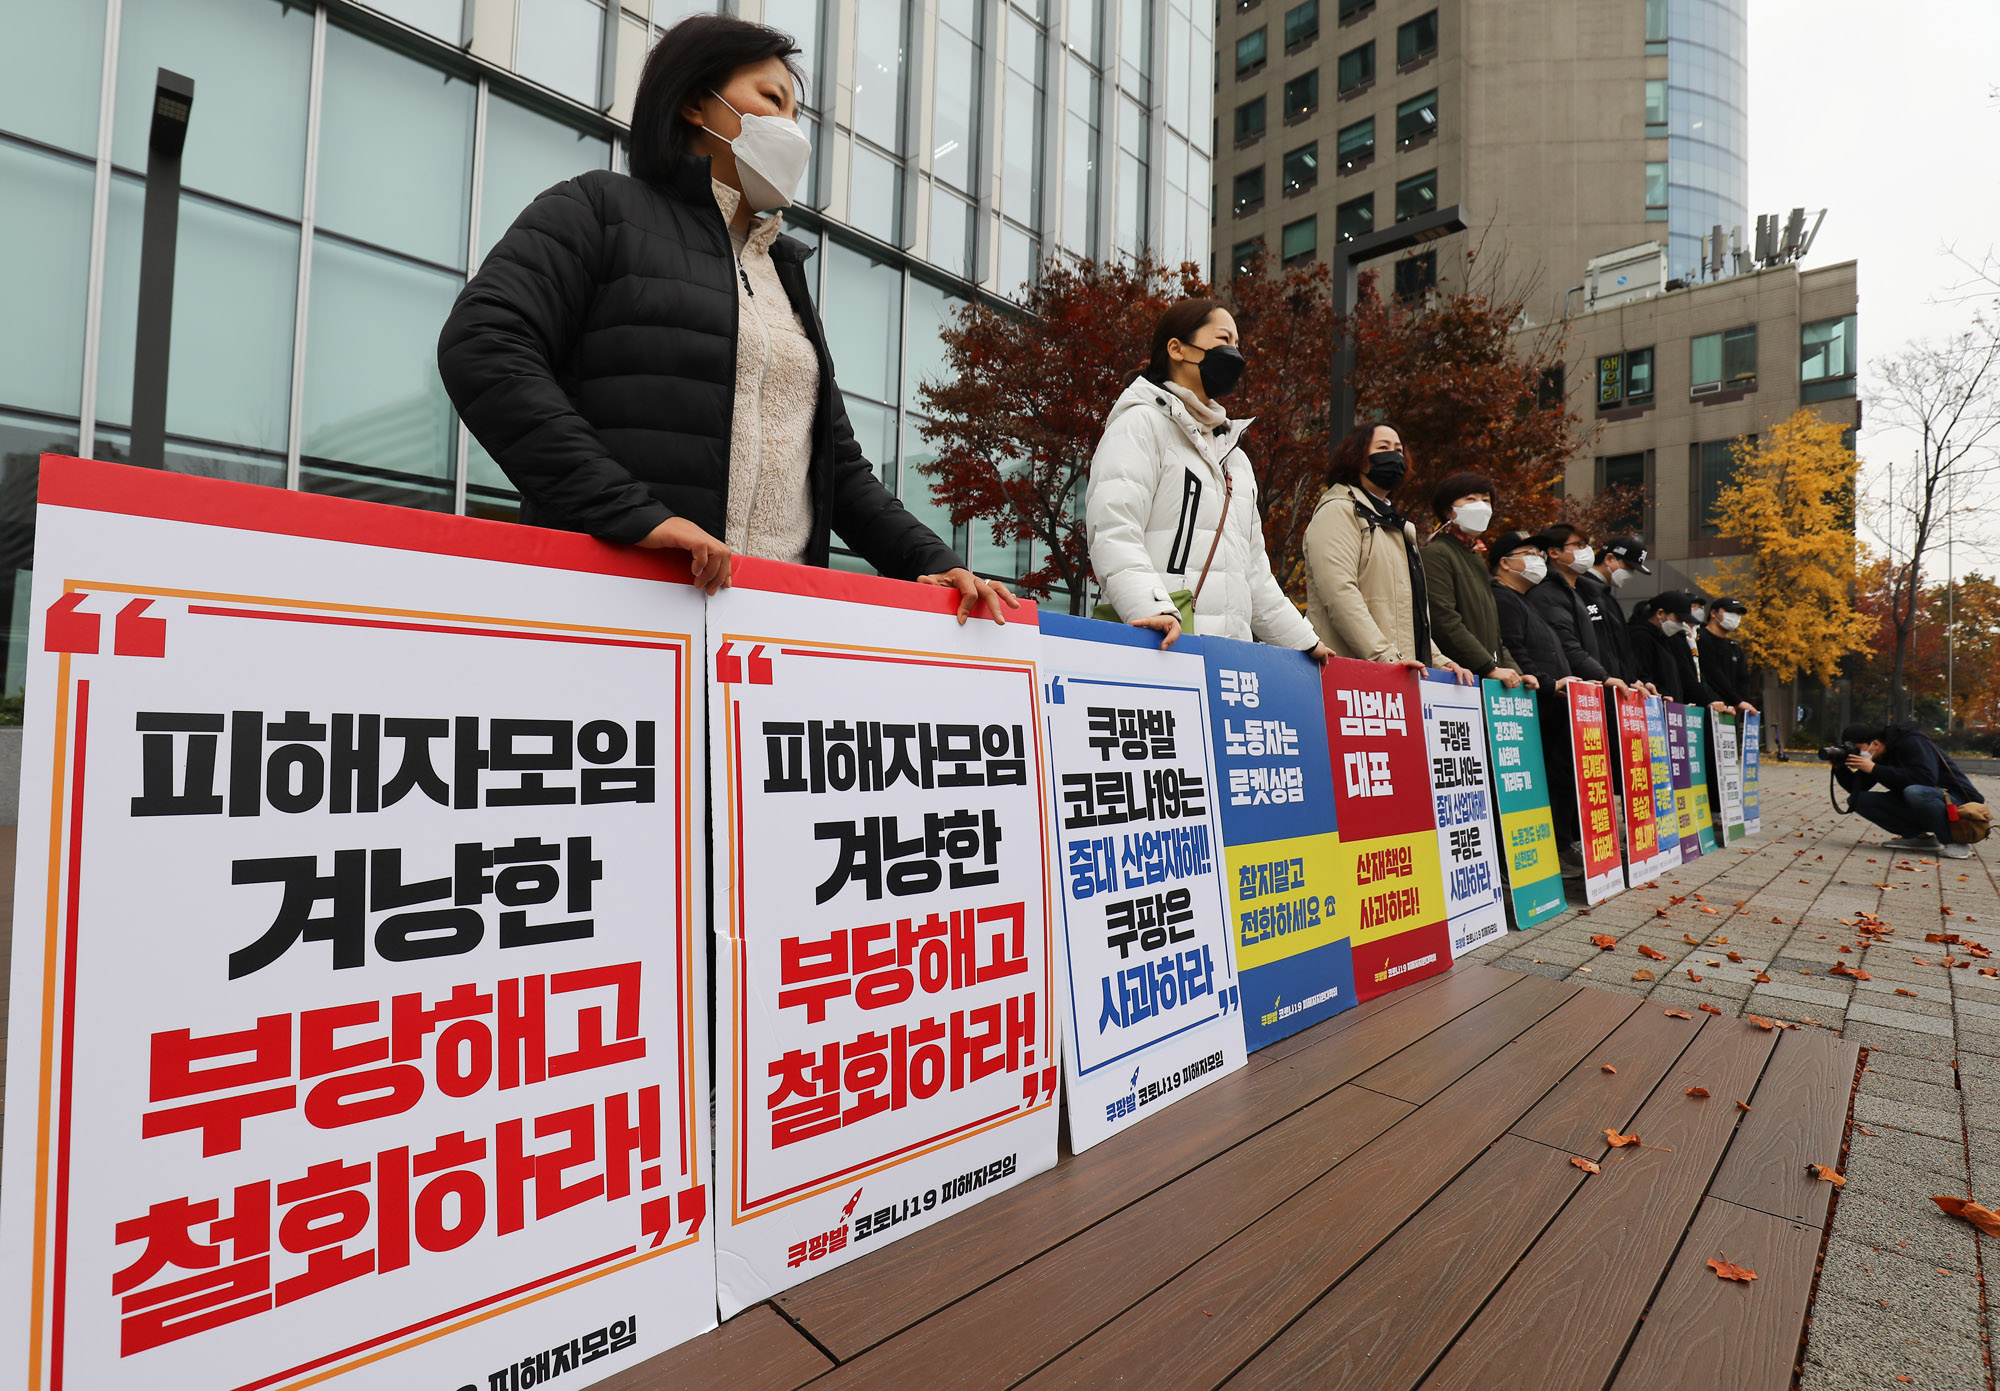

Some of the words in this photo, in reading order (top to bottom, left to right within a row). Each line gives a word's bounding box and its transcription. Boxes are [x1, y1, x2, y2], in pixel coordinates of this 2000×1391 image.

[1219, 669, 1260, 708] 쿠팡
[1336, 689, 1408, 737] 김범석
[1491, 696, 1514, 716] 노동자
[762, 720, 1027, 793] 피해자모임
[1087, 707, 1176, 761] 쿠팡발
[1224, 719, 1300, 757] 노동자는
[1439, 720, 1471, 752] 쿠팡발
[130, 711, 656, 818] 피해자모임
[1229, 766, 1305, 806] 로켓상담
[1343, 751, 1394, 799] 대표
[1433, 756, 1484, 789] 코로나19는
[1062, 768, 1206, 829] 코로나19는
[1436, 794, 1454, 828] 중대
[814, 809, 1002, 905] 겨냥한
[1068, 836, 1118, 900] 중대
[1122, 824, 1211, 890] 산업재해!!
[1356, 845, 1412, 886] 산재책임
[1450, 826, 1482, 863] 쿠팡은
[1239, 857, 1305, 901] 참지말고
[1450, 860, 1491, 902] 사과하라
[229, 835, 603, 981] 겨냥한
[1105, 887, 1195, 959] 쿠팡은
[1240, 895, 1321, 947] 전화하세요
[1360, 886, 1420, 930] 사과하라!
[779, 901, 1028, 1024] 부당해고
[1099, 944, 1214, 1035] 사과하라
[1278, 1001, 1303, 1020] 코로나19
[142, 961, 646, 1158] 부당해고
[768, 992, 1036, 1150] 철회하라!
[1106, 1092, 1137, 1122] 쿠팡발
[1138, 1072, 1181, 1107] 코로나19
[1183, 1050, 1224, 1084] 피해자모임
[112, 1084, 662, 1358] 철회하라!
[787, 1223, 849, 1268] 쿠팡발
[854, 1189, 937, 1242] 코로나19
[941, 1153, 1017, 1204] 피해자모임
[488, 1315, 637, 1391] 피해자모임
